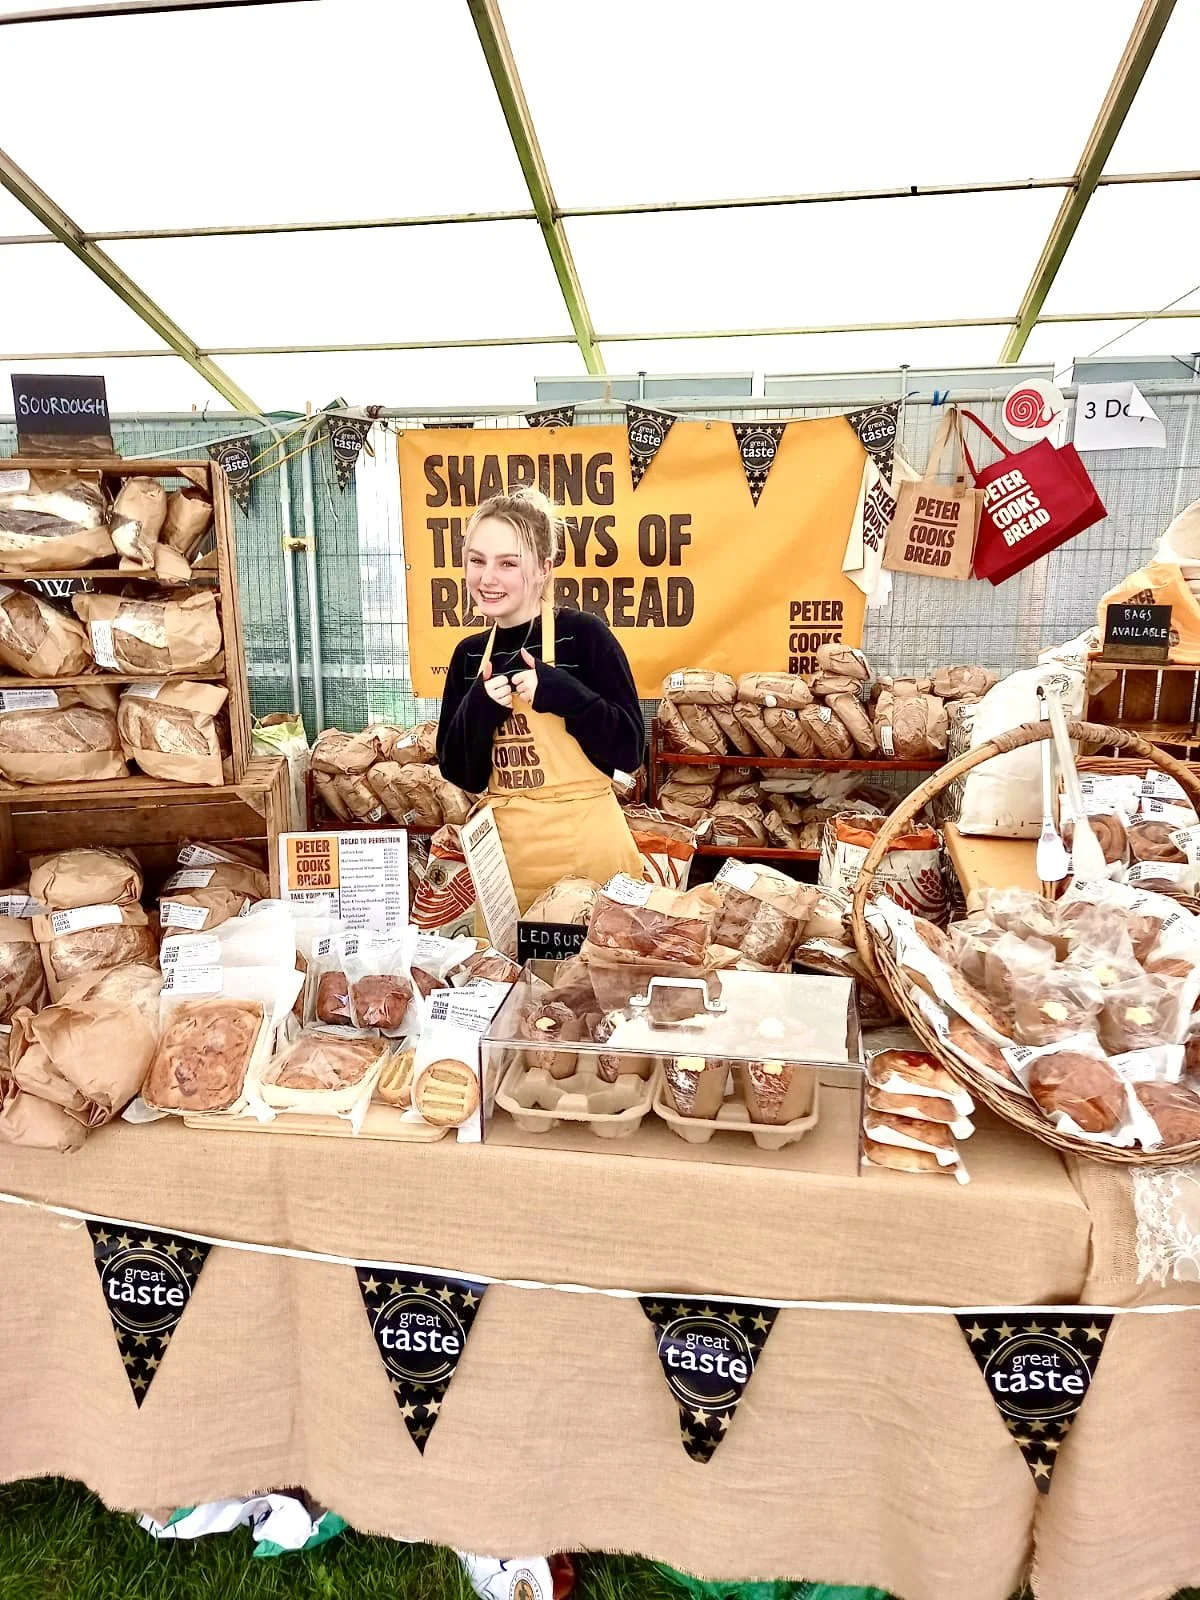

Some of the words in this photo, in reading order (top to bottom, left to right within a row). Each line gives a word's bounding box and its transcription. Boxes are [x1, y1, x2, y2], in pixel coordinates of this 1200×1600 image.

[19, 394, 105, 416] SOURDOUGH
[1084, 401, 1096, 419] 3
[639, 425, 656, 435] great
[861, 425, 896, 443] taste
[867, 420, 886, 431] great
[334, 437, 362, 450] taste
[341, 433, 356, 441] great
[630, 431, 662, 447] taste
[749, 440, 767, 449] great
[742, 446, 775, 459] taste
[221, 458, 249, 472] taste
[424, 452, 615, 507] SHARING
[983, 469, 1028, 507] PETER
[915, 496, 960, 521] PETER
[992, 491, 1040, 529] COOKS
[908, 524, 955, 549] COOKS
[1002, 508, 1051, 547] BREAD
[427, 518, 465, 568] TH
[553, 514, 618, 568] OYS
[638, 514, 692, 567] OF
[904, 544, 952, 567] BREAD
[554, 576, 694, 628] BREAD
[790, 600, 844, 621] PETER
[1124, 609, 1152, 621] BAGS
[1112, 626, 1168, 638] AVAILABLE
[788, 656, 820, 675] BRE
[295, 839, 330, 853] PETER
[296, 859, 331, 873] COOKS
[297, 873, 331, 886] BREAD
[290, 893, 305, 901] TAKE
[124, 1267, 167, 1284] great
[107, 1277, 184, 1307] taste
[399, 1312, 441, 1328] great
[380, 1325, 460, 1355] taste
[685, 1332, 730, 1351] great
[665, 1345, 748, 1385] taste
[1012, 1351, 1061, 1369] great
[991, 1368, 1085, 1395] taste
